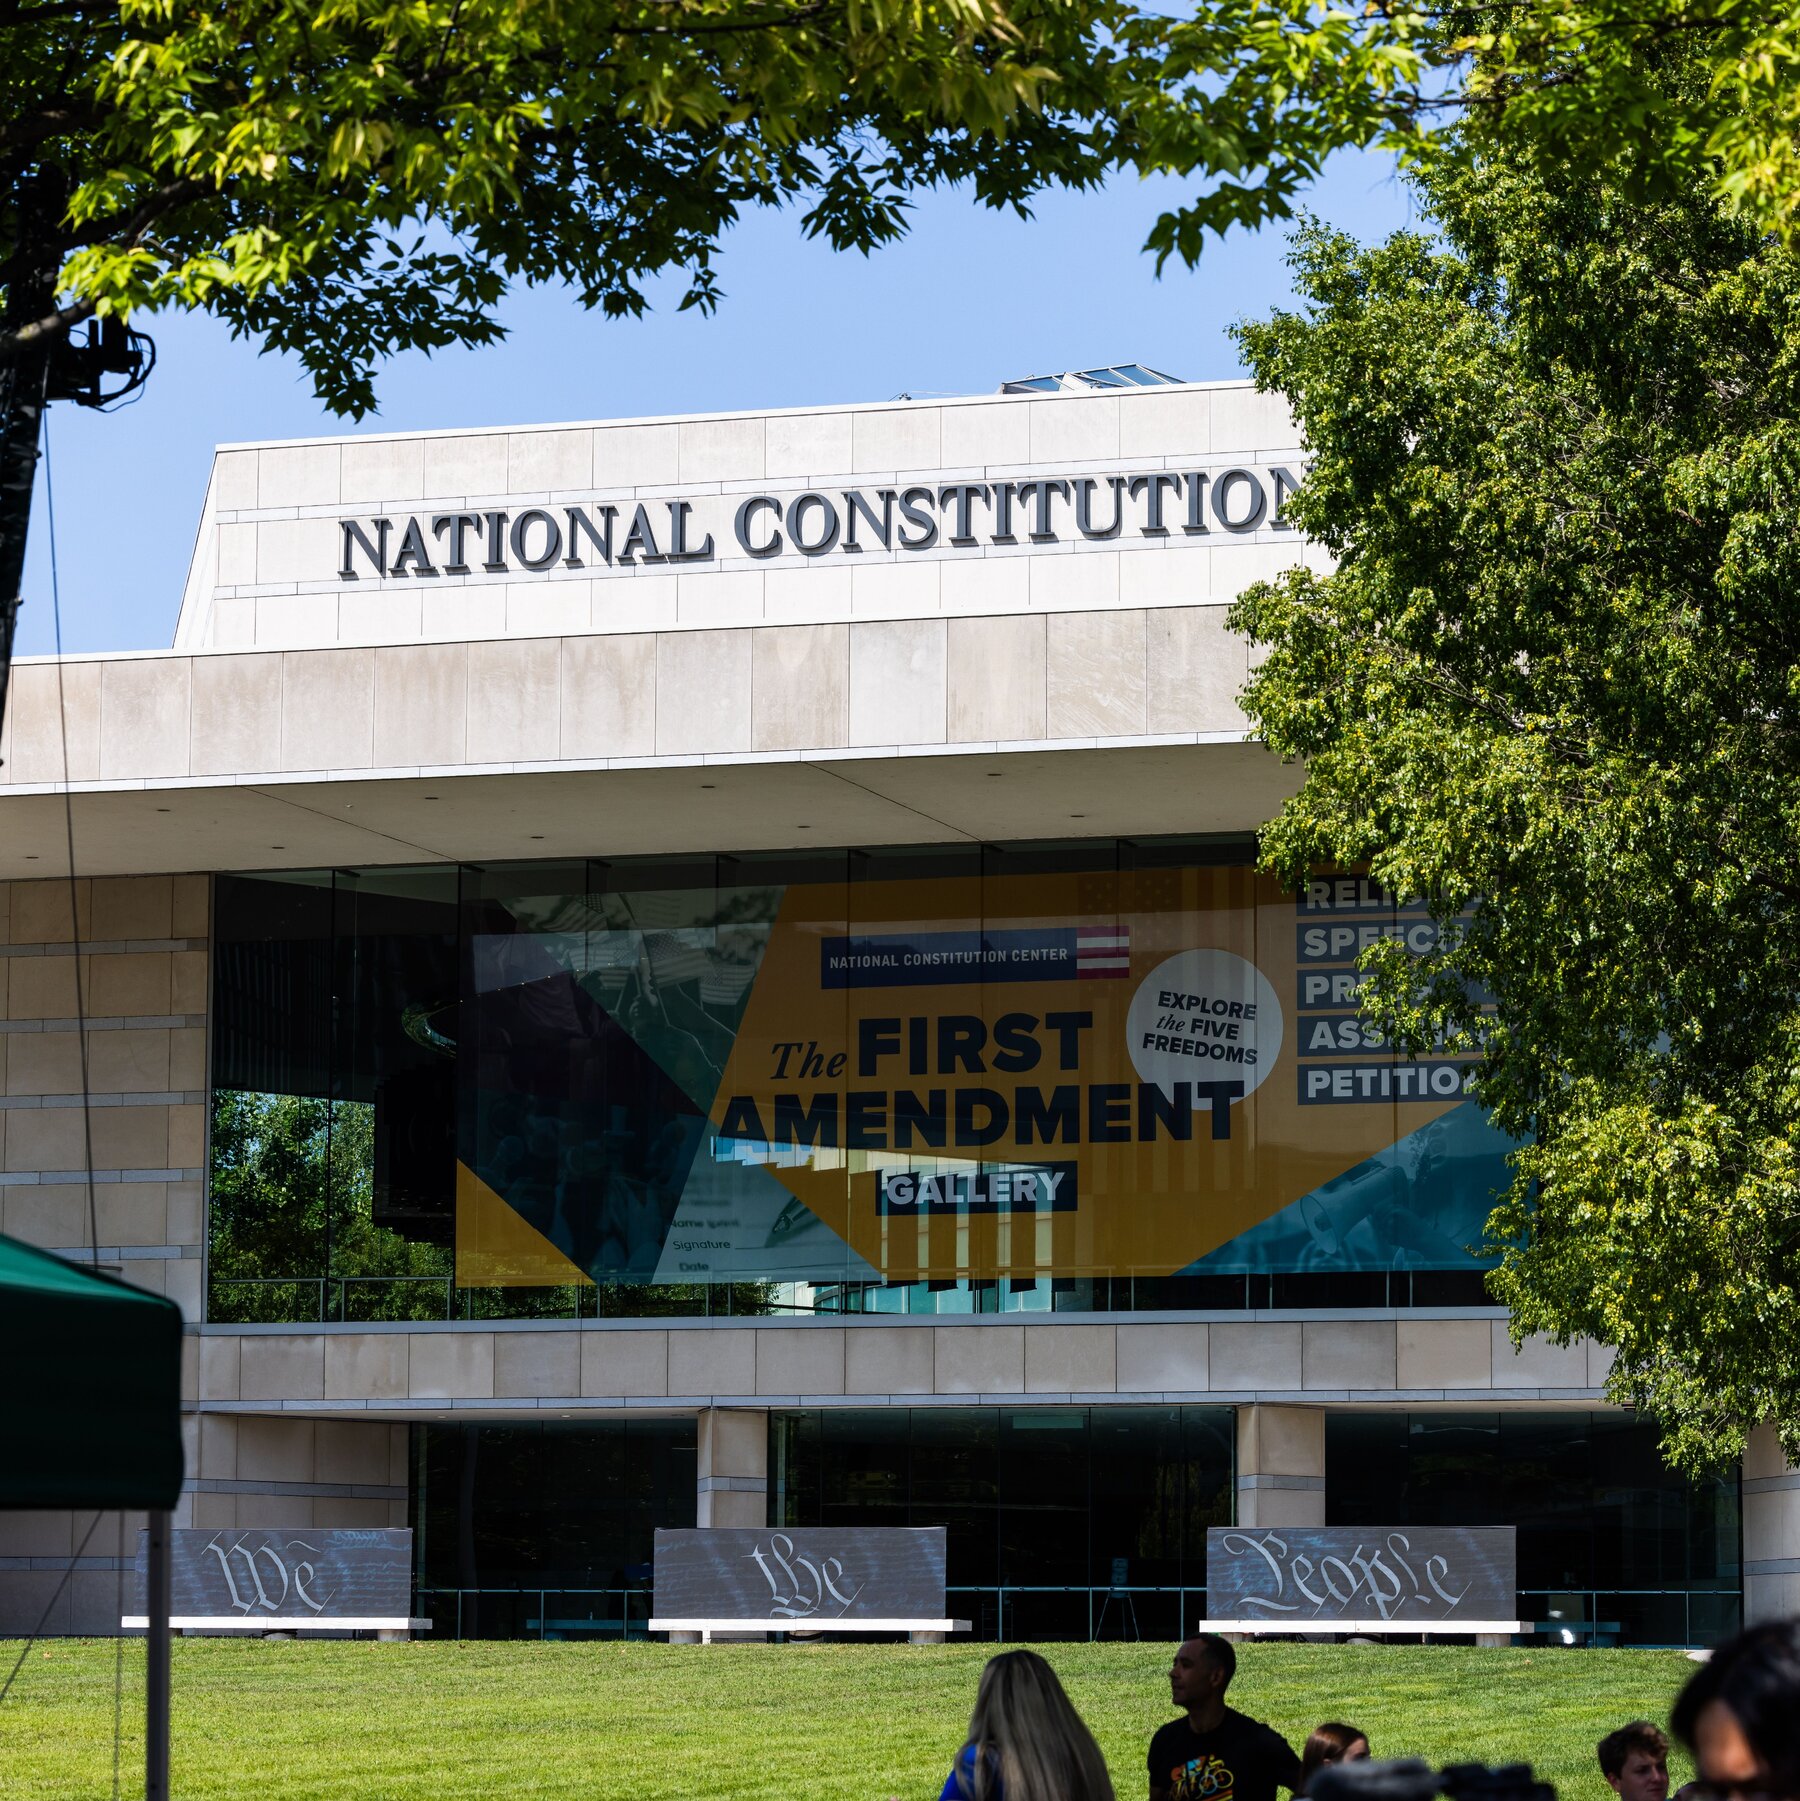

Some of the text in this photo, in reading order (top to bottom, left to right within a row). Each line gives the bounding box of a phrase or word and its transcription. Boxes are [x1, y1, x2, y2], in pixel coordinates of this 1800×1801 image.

[338, 501, 714, 580] NATIONAL
[829, 948, 1068, 969] NATIONAL CONSTITUTION CENTER
[1158, 991, 1257, 1021] EXPLORE
[1156, 1014, 1240, 1040] the FIVE
[770, 1011, 1093, 1080] The FIRST
[1142, 1032, 1258, 1065] FREEDOMS
[717, 1080, 1245, 1153] AMENDMENT
[886, 1172, 1066, 1205] GALLERY
[672, 1240, 731, 1252] Signature
[679, 1262, 710, 1272] Date
[201, 1531, 336, 1617] We
[740, 1533, 865, 1619] the
[1222, 1530, 1473, 1620] People
